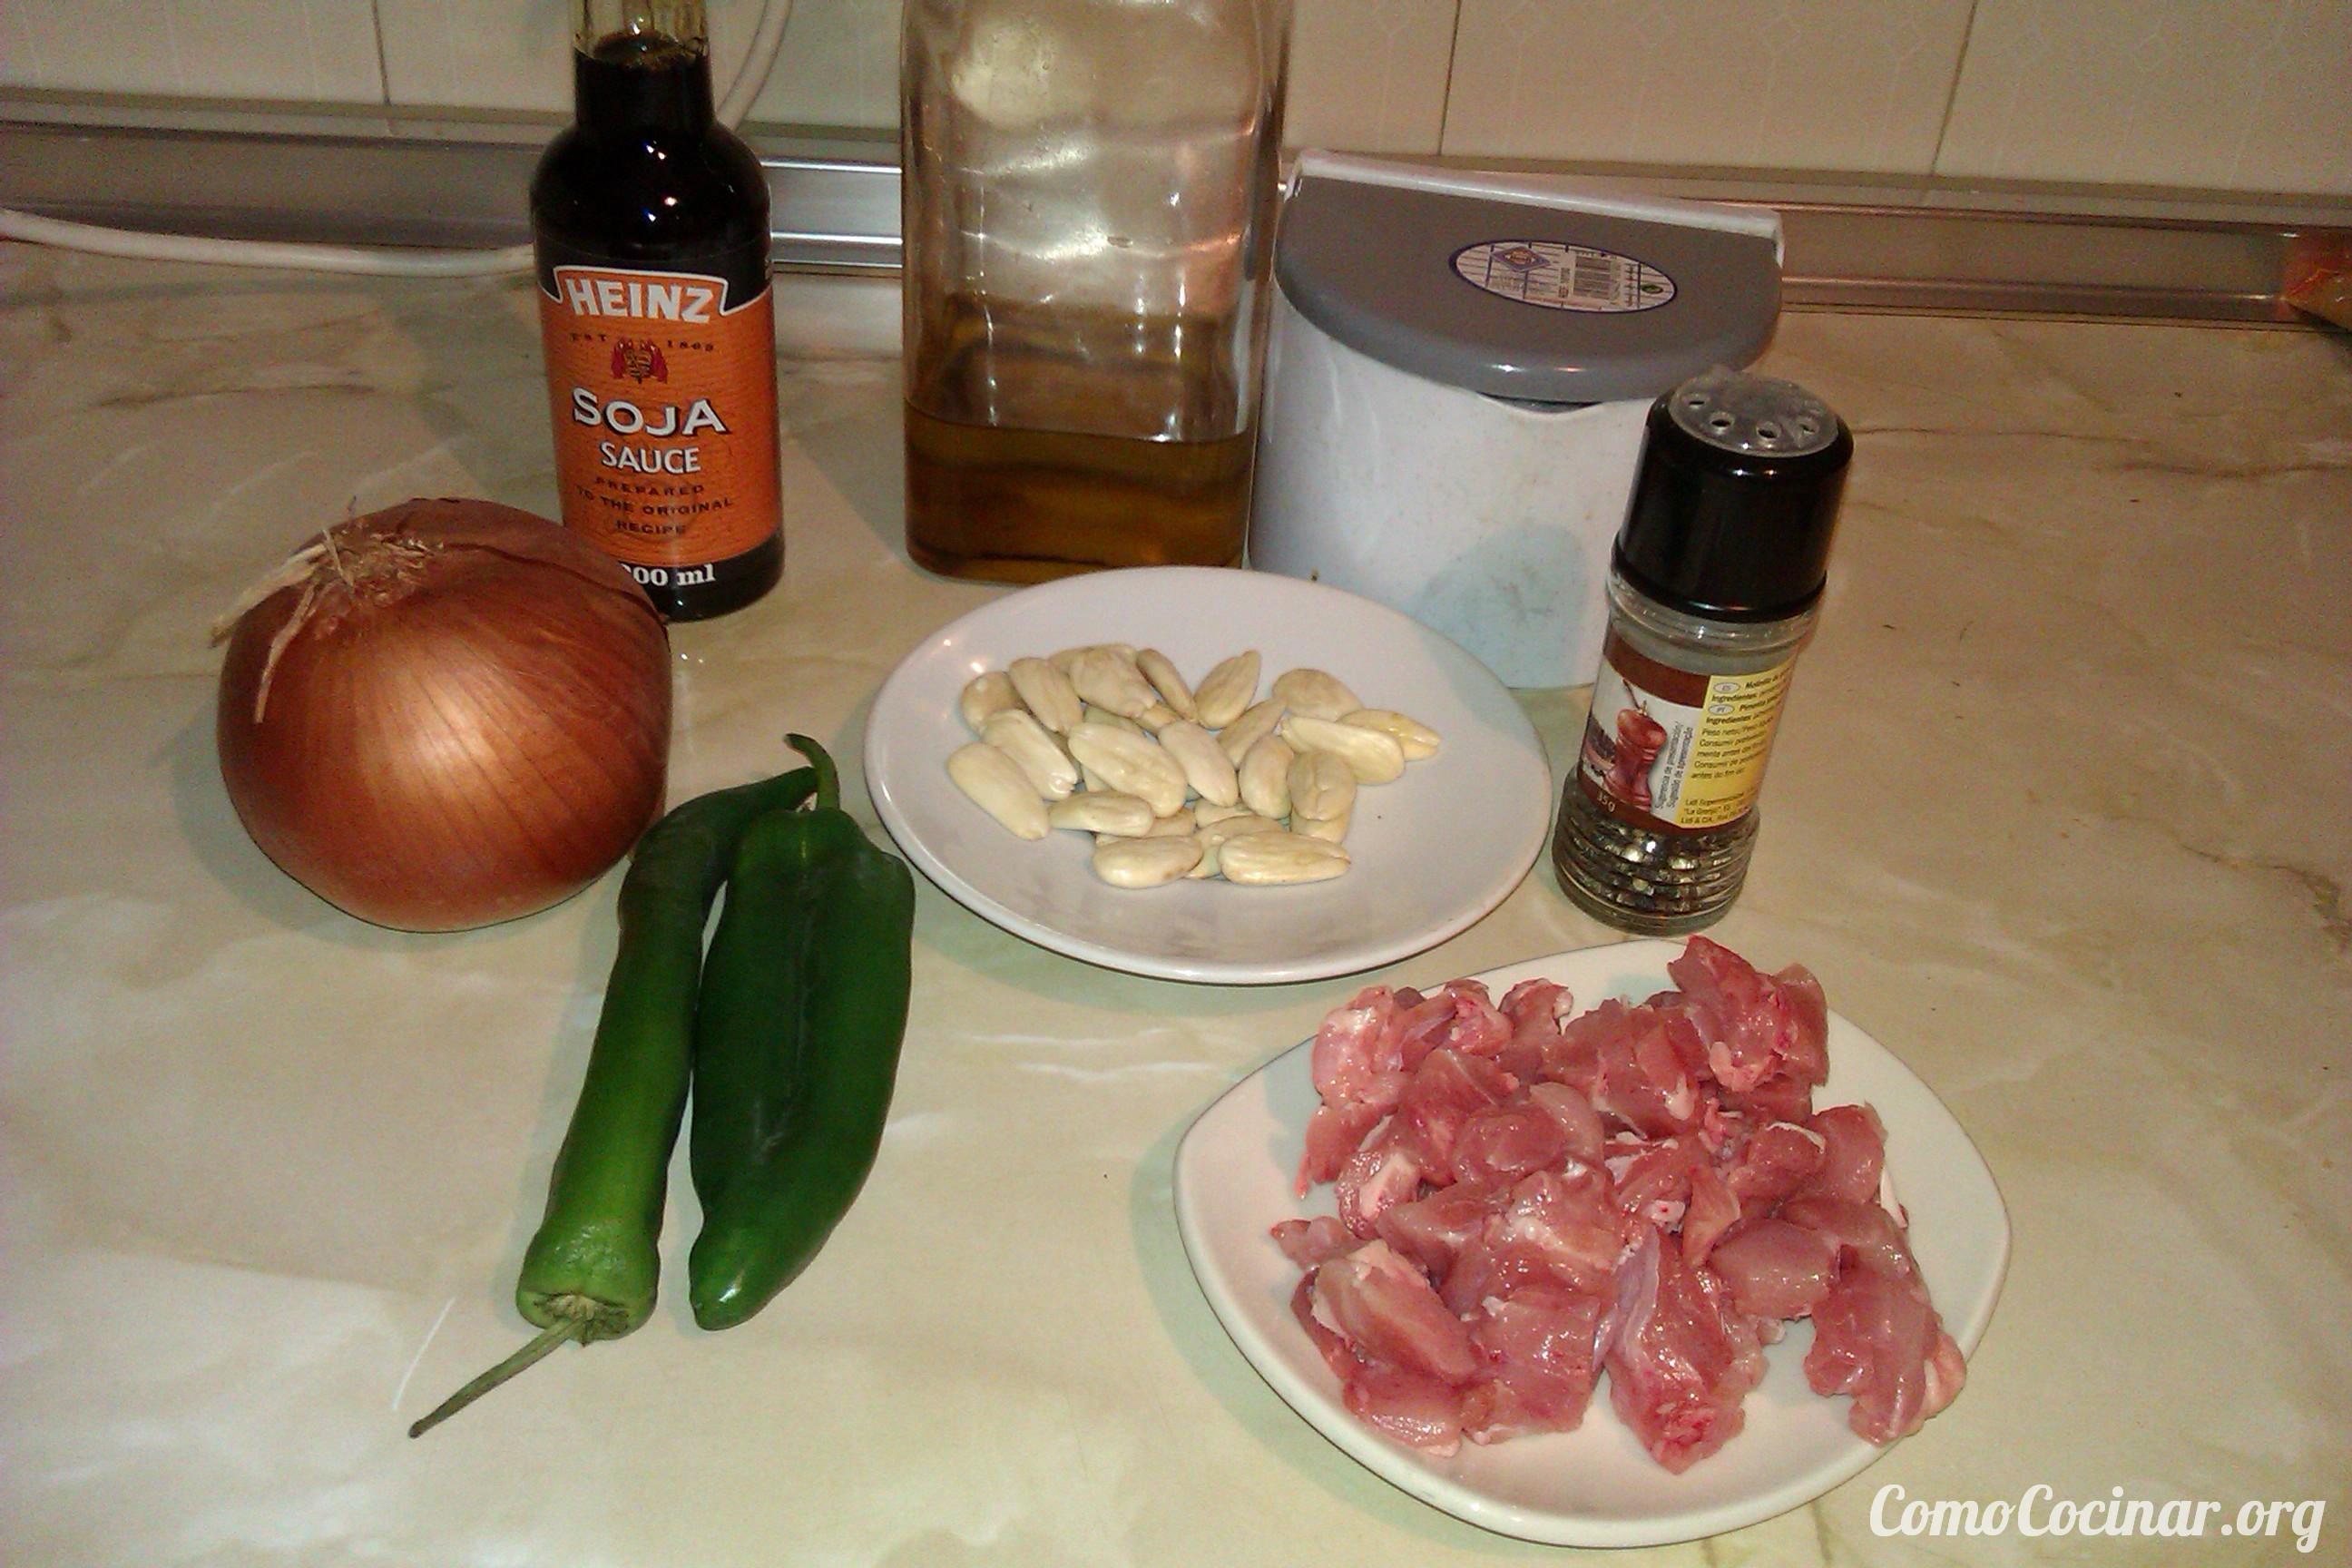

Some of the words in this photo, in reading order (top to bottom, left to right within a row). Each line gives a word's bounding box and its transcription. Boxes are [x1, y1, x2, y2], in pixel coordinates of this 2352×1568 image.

[565, 278, 713, 324] HEINZ
[573, 387, 729, 436] SOJA
[600, 441, 701, 474] SAUCE
[595, 475, 704, 495] PREPARED
[601, 495, 633, 512] THE
[642, 496, 733, 516] ORIGINAL
[616, 519, 687, 535] RECIPE
[621, 563, 669, 587] 00
[676, 563, 717, 586] ml
